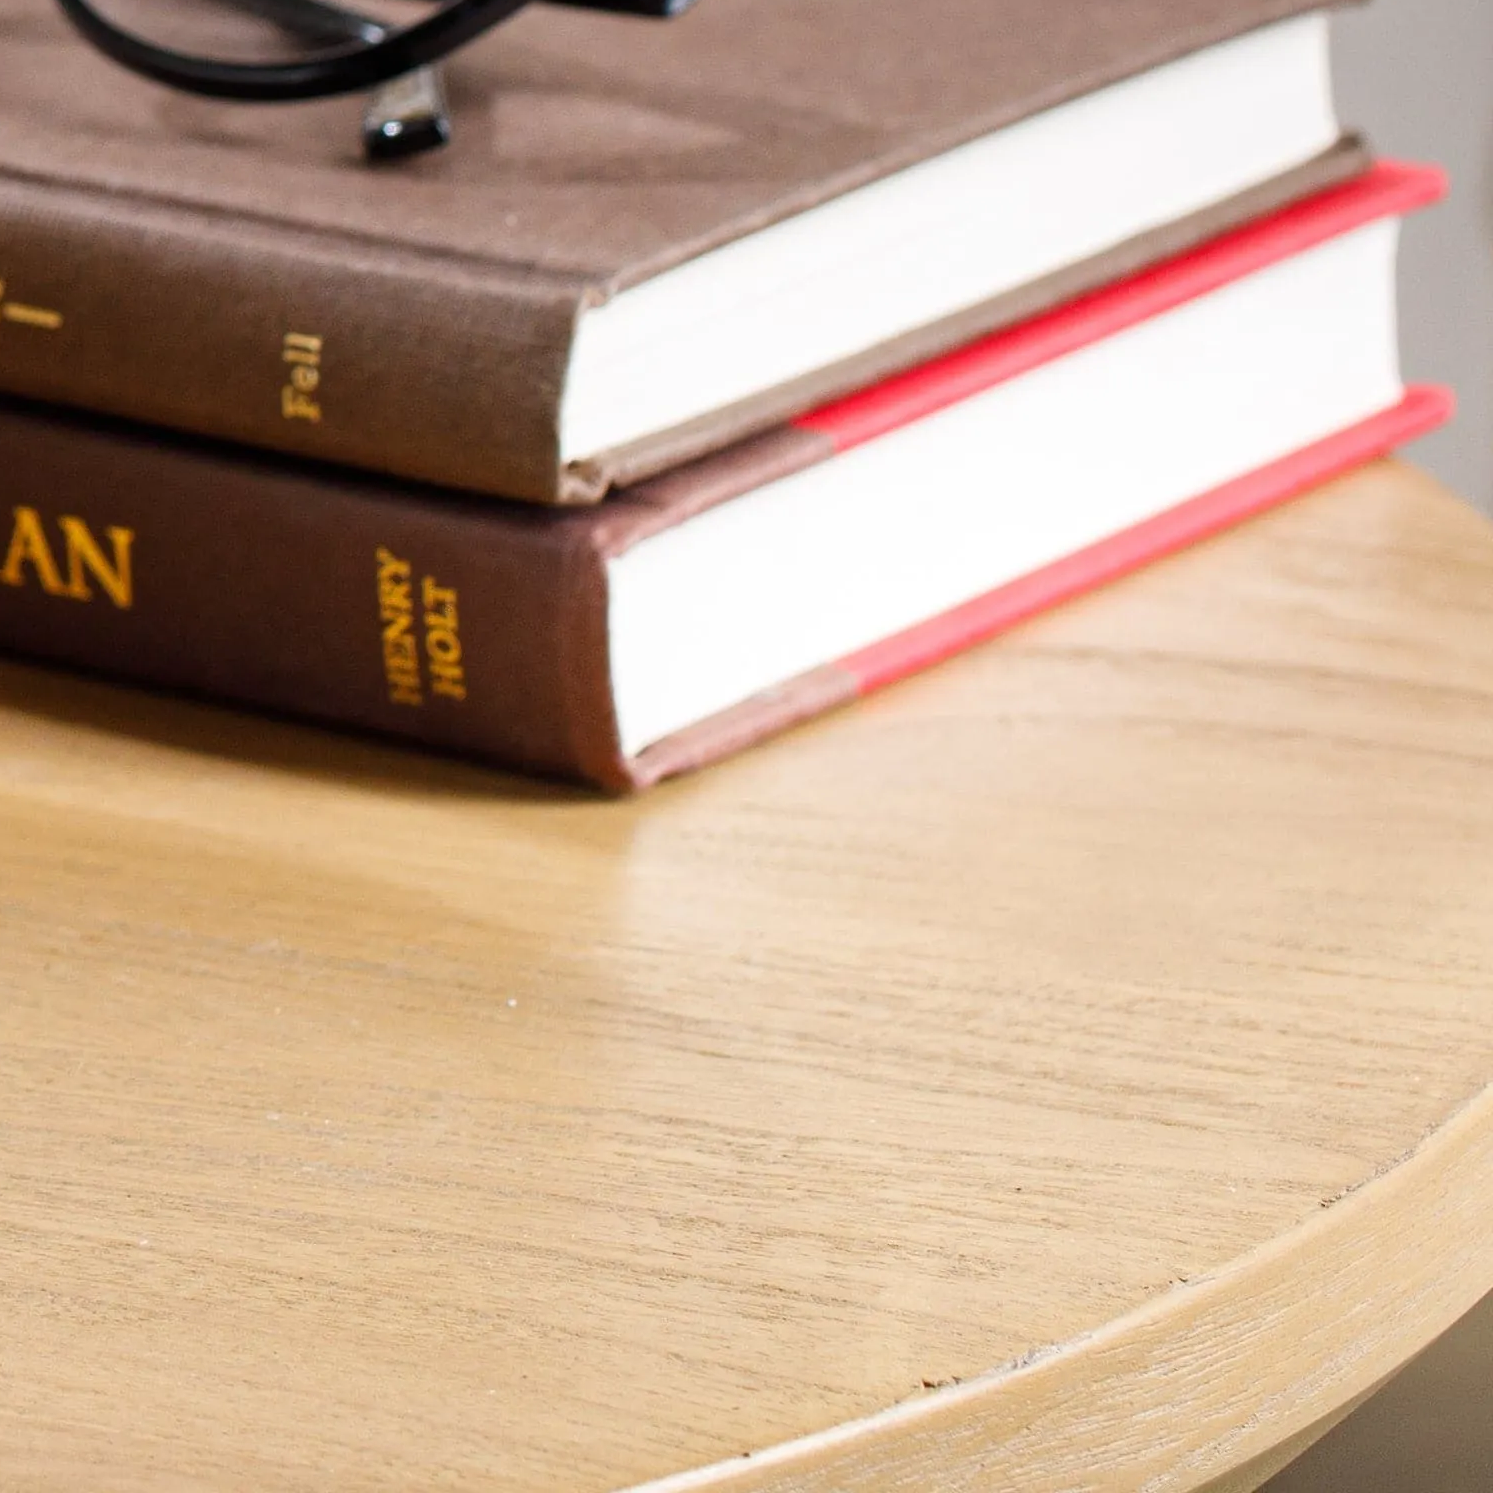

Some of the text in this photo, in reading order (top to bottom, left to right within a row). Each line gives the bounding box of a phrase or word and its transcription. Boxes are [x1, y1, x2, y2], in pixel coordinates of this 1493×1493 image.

[281, 333, 323, 421] Fell
[375, 545, 422, 705] HENRY
[422, 576, 467, 701] HOLT
